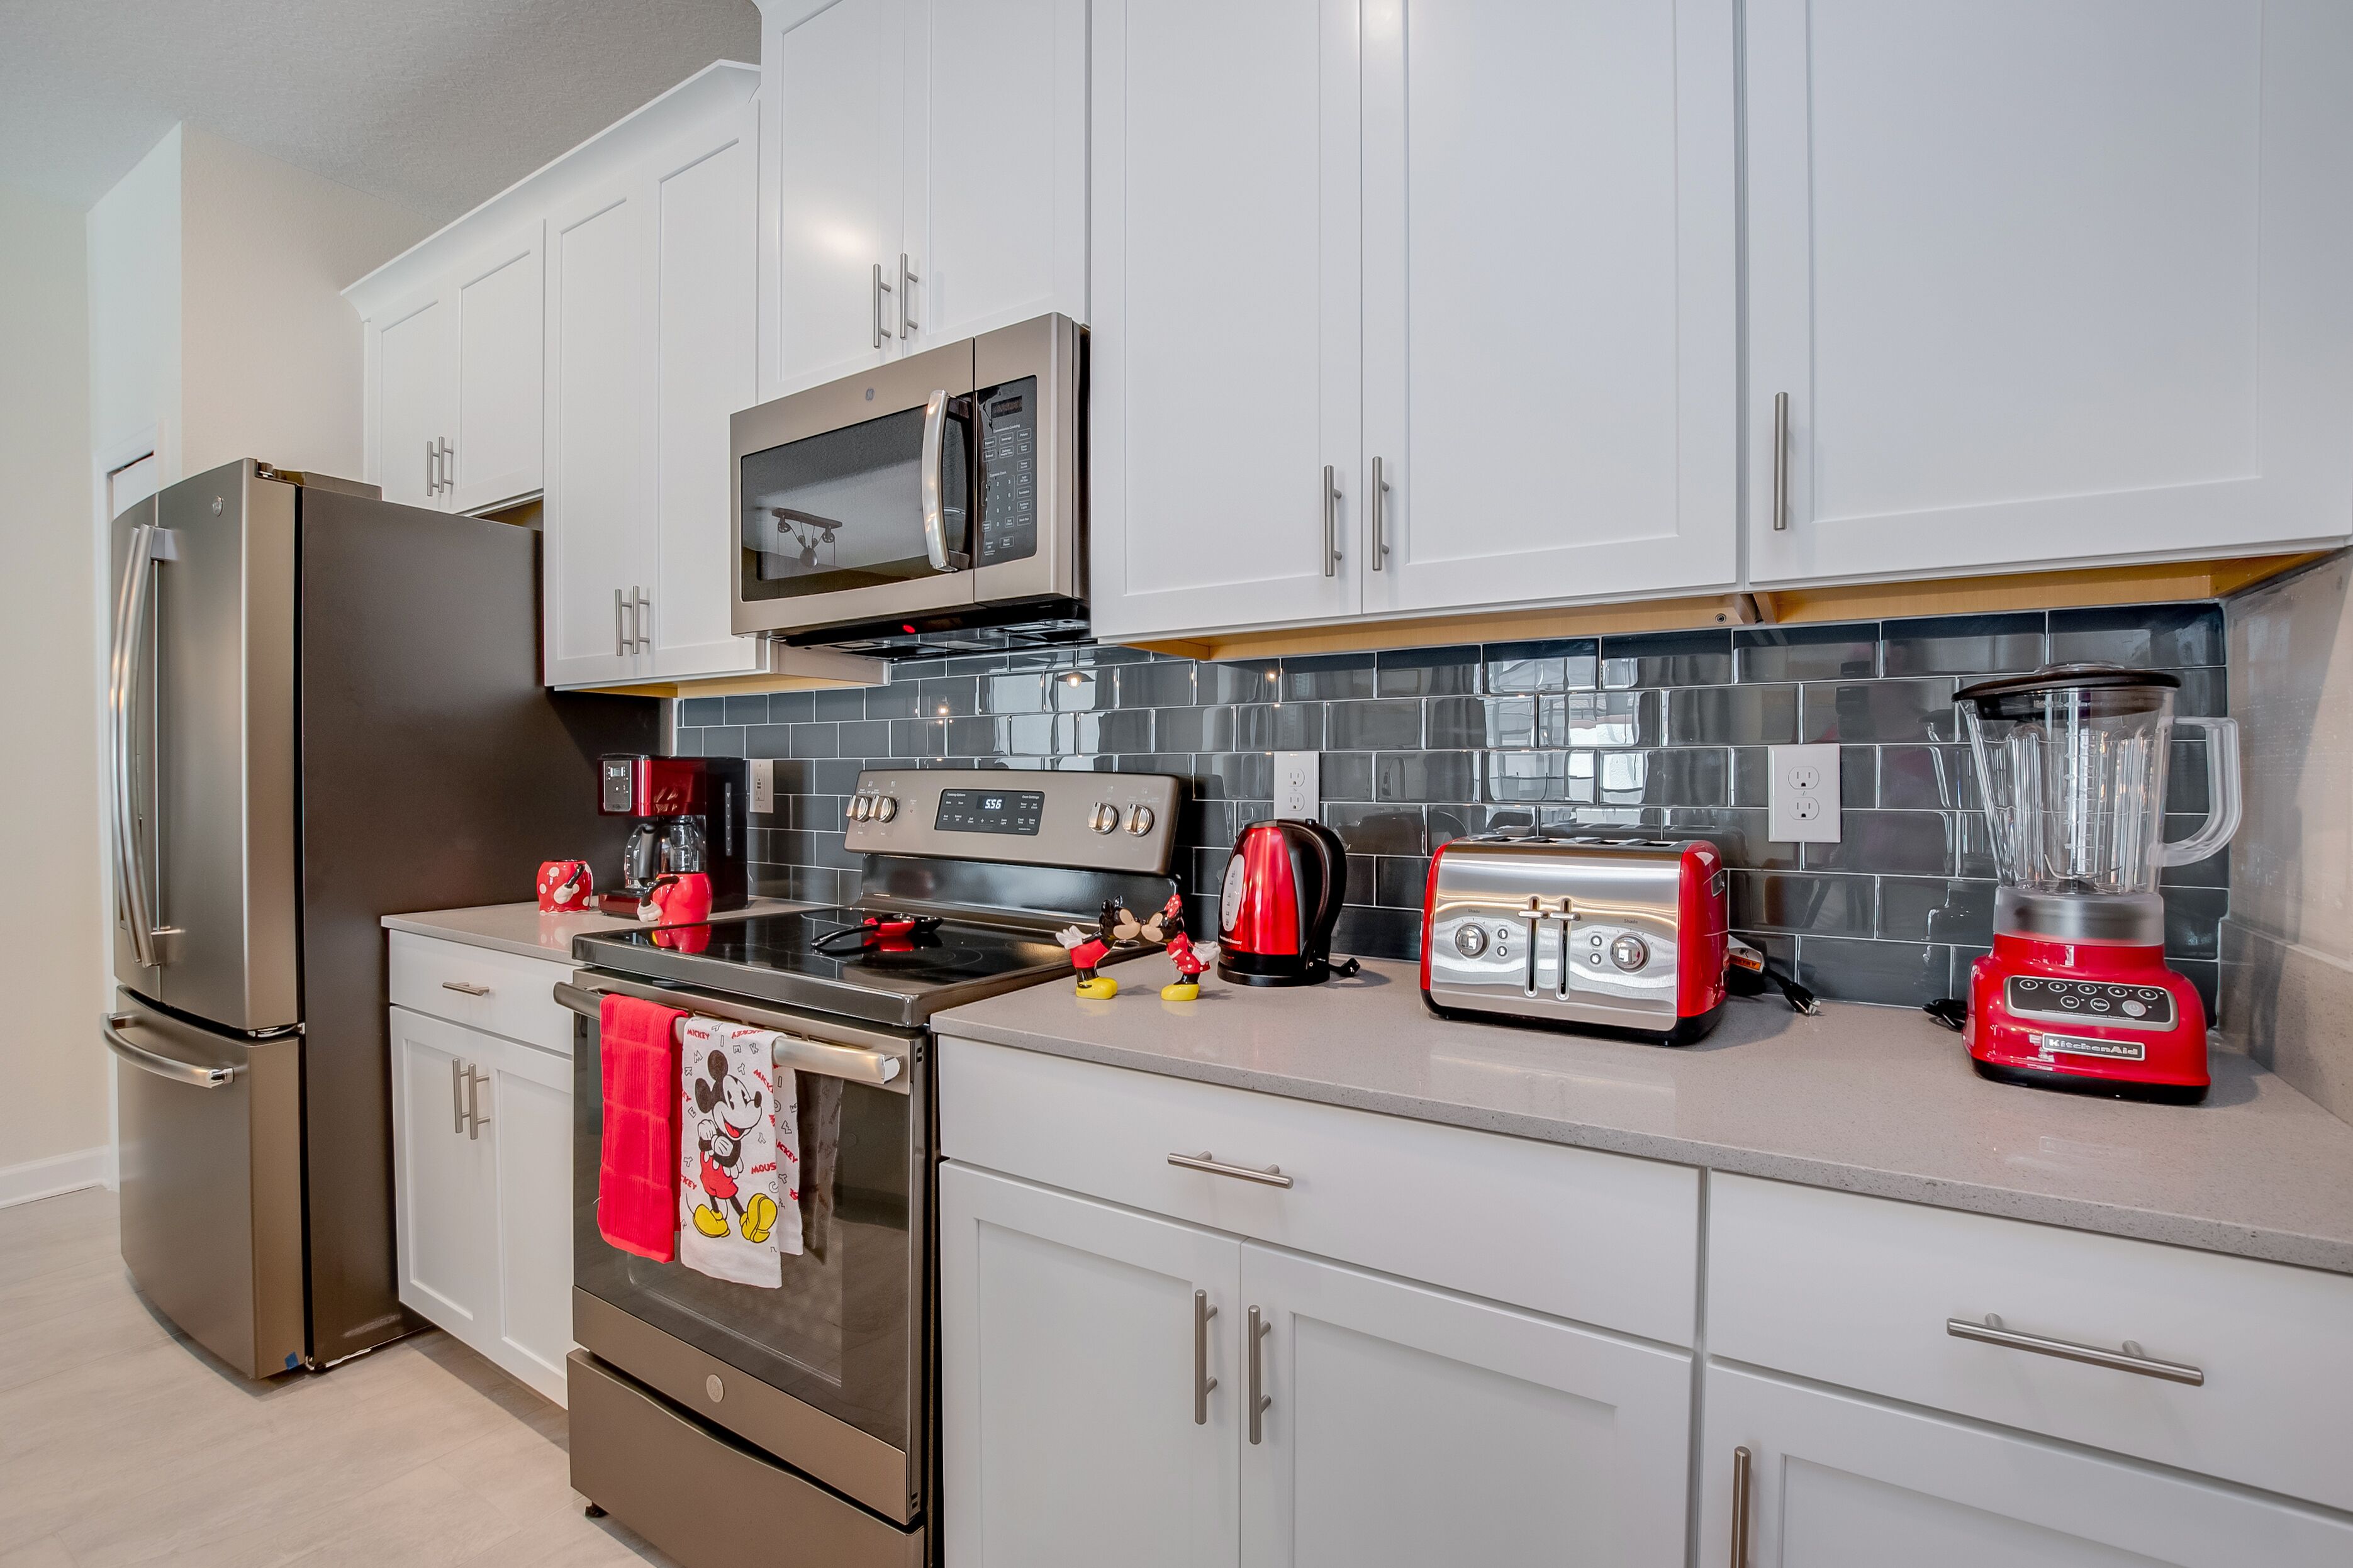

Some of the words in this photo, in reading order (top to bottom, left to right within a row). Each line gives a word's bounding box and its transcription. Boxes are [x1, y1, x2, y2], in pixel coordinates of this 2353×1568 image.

[687, 1029, 710, 1040] MICKEY
[2048, 1038, 2138, 1055] KitchenAid
[776, 1138, 798, 1164] ICKEY
